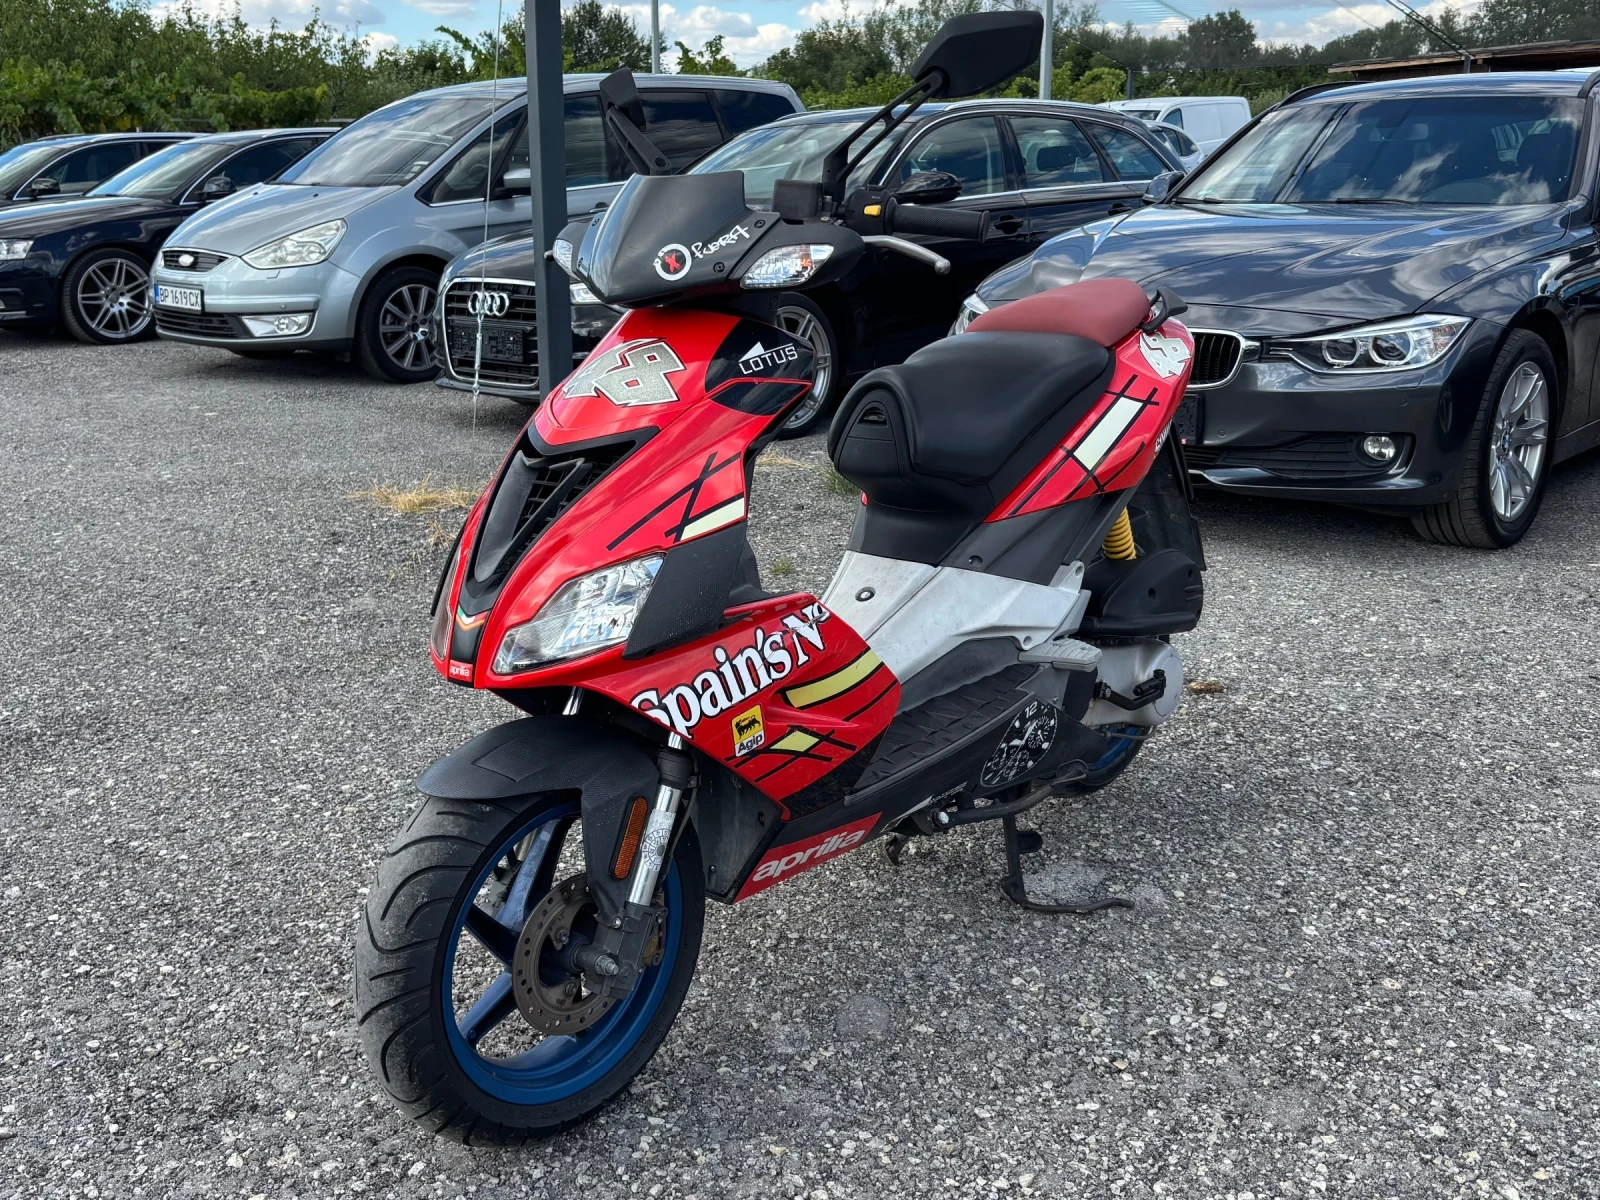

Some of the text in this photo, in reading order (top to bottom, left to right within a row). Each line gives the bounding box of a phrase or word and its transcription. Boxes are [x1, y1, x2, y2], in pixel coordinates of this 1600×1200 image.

[170, 289, 188, 306] 1619
[738, 346, 798, 375] LOTUS
[449, 664, 470, 677] aprilia
[630, 626, 793, 740] Spain's
[1024, 700, 1038, 719] 12
[737, 733, 764, 755] Agip
[752, 829, 866, 882] aprilia
